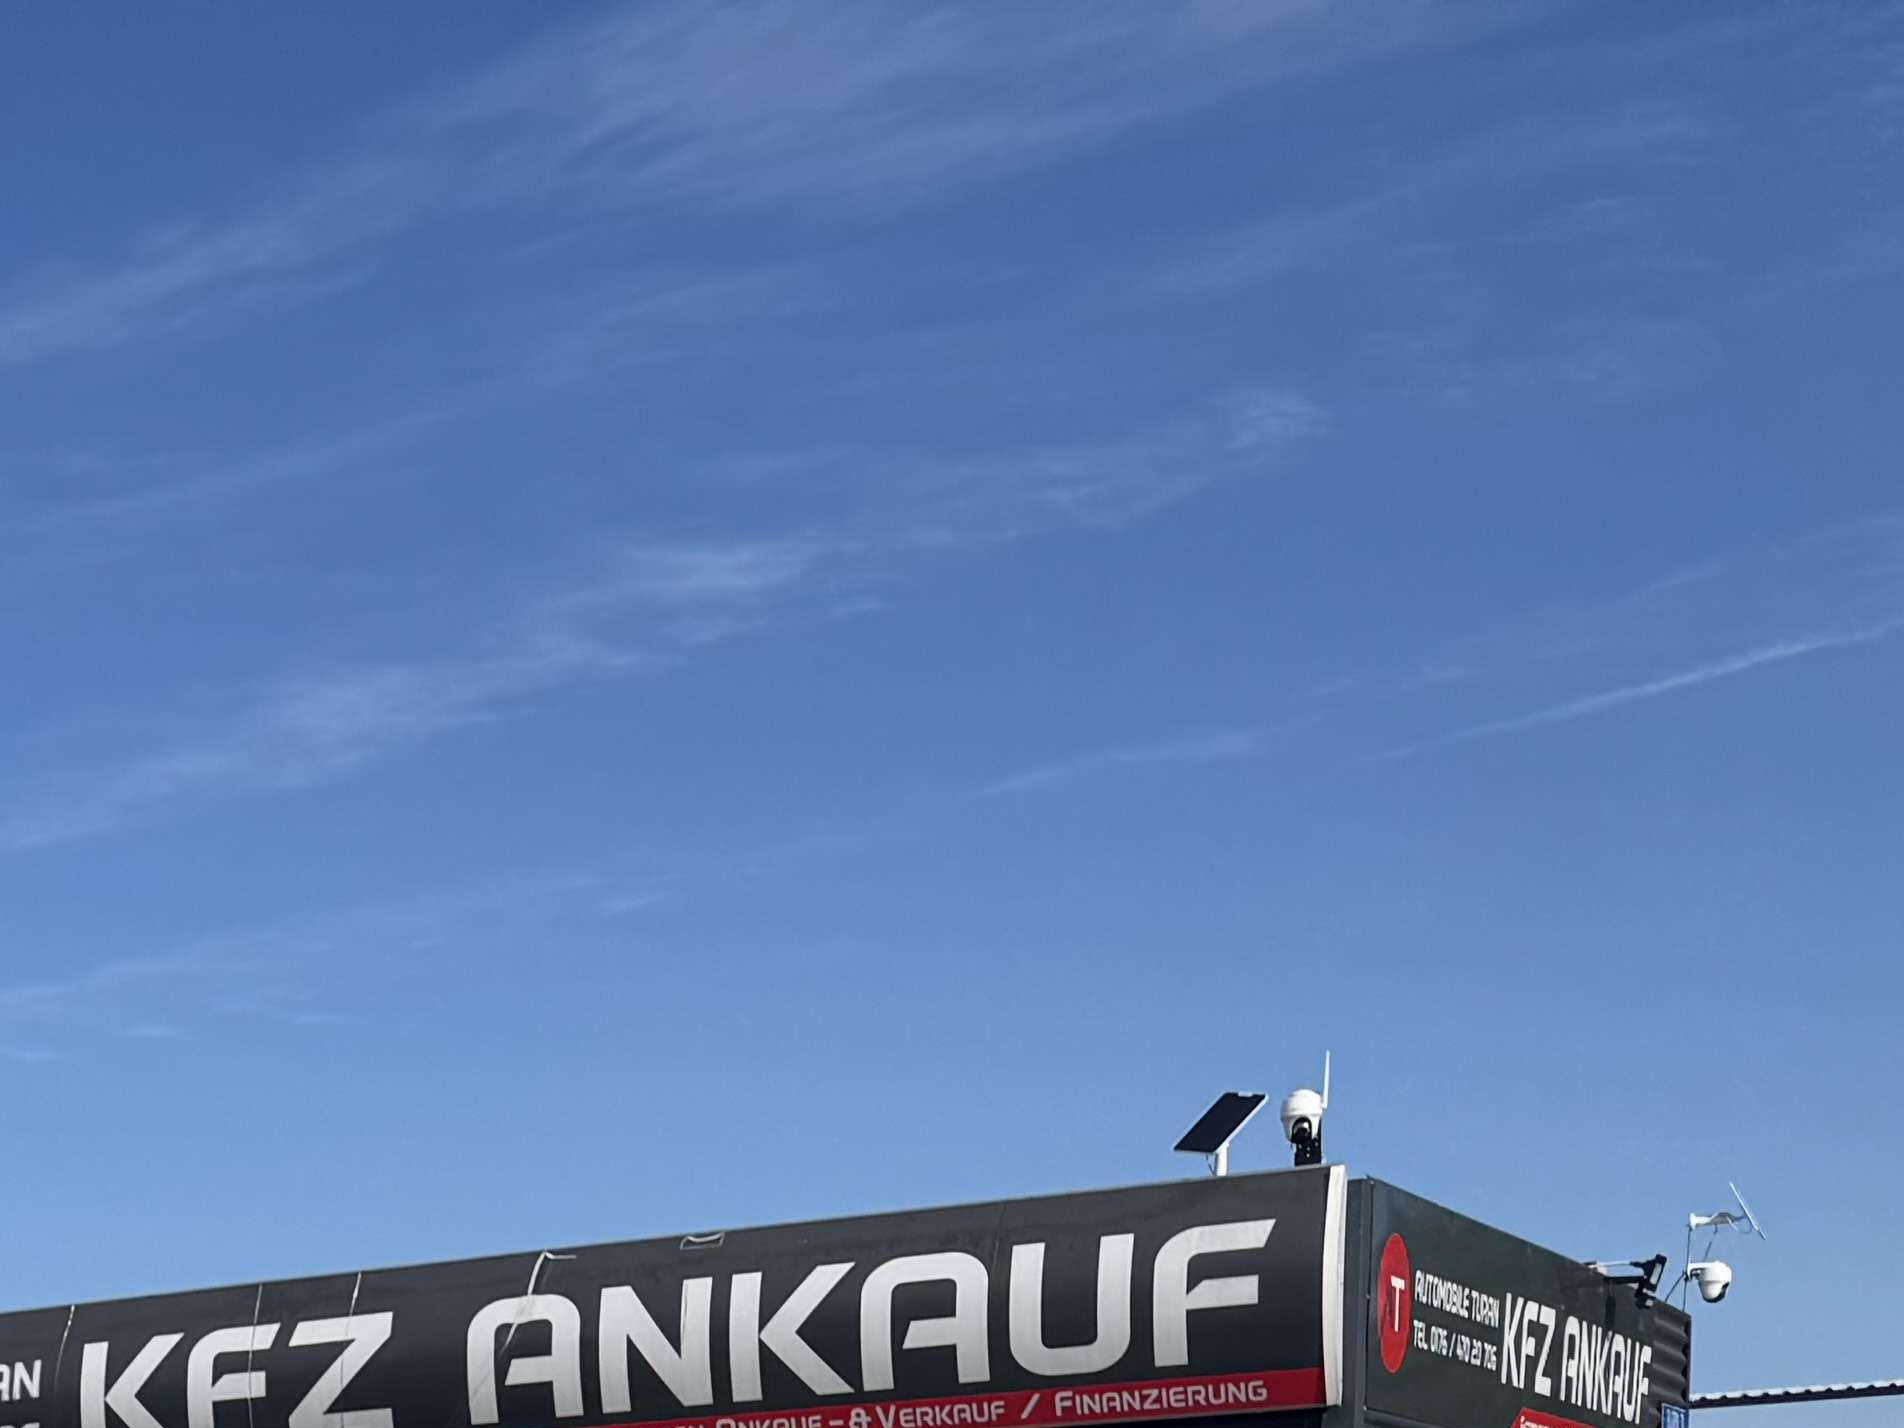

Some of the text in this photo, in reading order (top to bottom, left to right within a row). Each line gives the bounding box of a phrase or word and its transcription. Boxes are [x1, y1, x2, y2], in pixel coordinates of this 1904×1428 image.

[466, 1217, 1277, 1425] ANKAUF
[1414, 1269, 1470, 1319] AUTOMOBILE
[1501, 1292, 1652, 1424] KFZ ANKAUF
